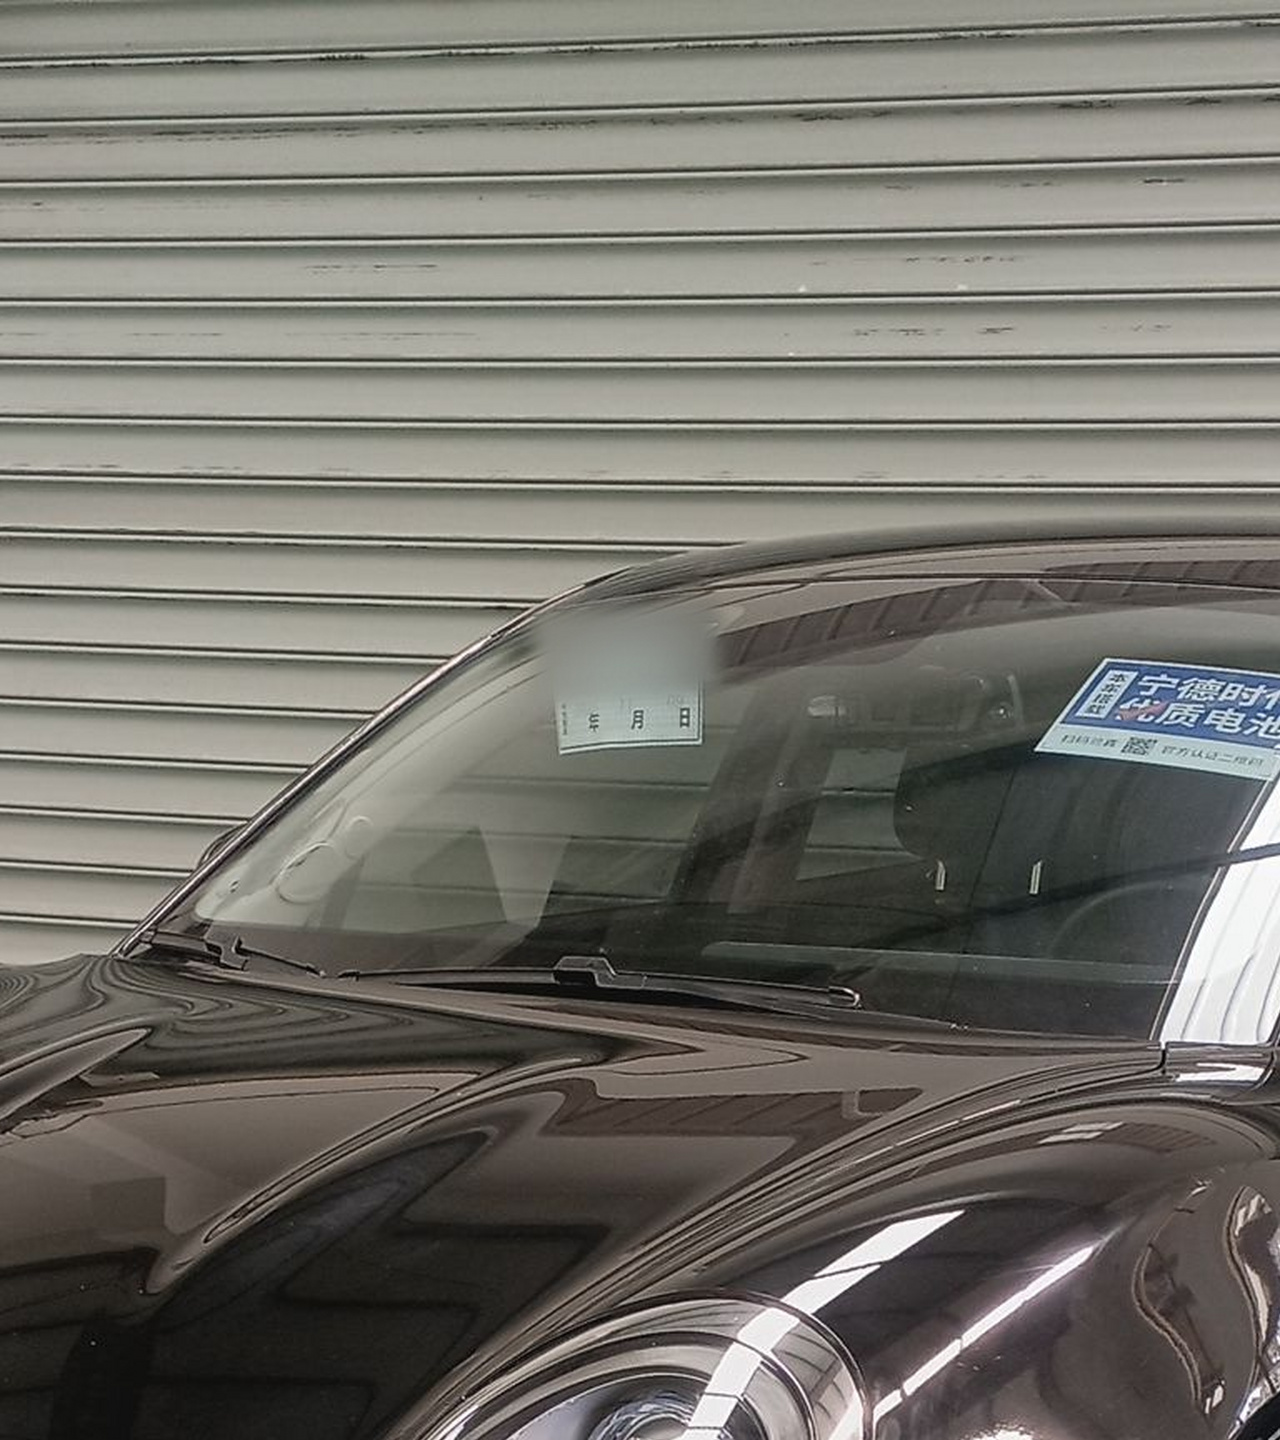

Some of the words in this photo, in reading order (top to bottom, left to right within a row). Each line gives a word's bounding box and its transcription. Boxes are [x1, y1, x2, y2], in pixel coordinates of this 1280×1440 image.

[588, 713, 601, 733] 年
[631, 709, 645, 730] 月
[679, 707, 691, 728] 日
